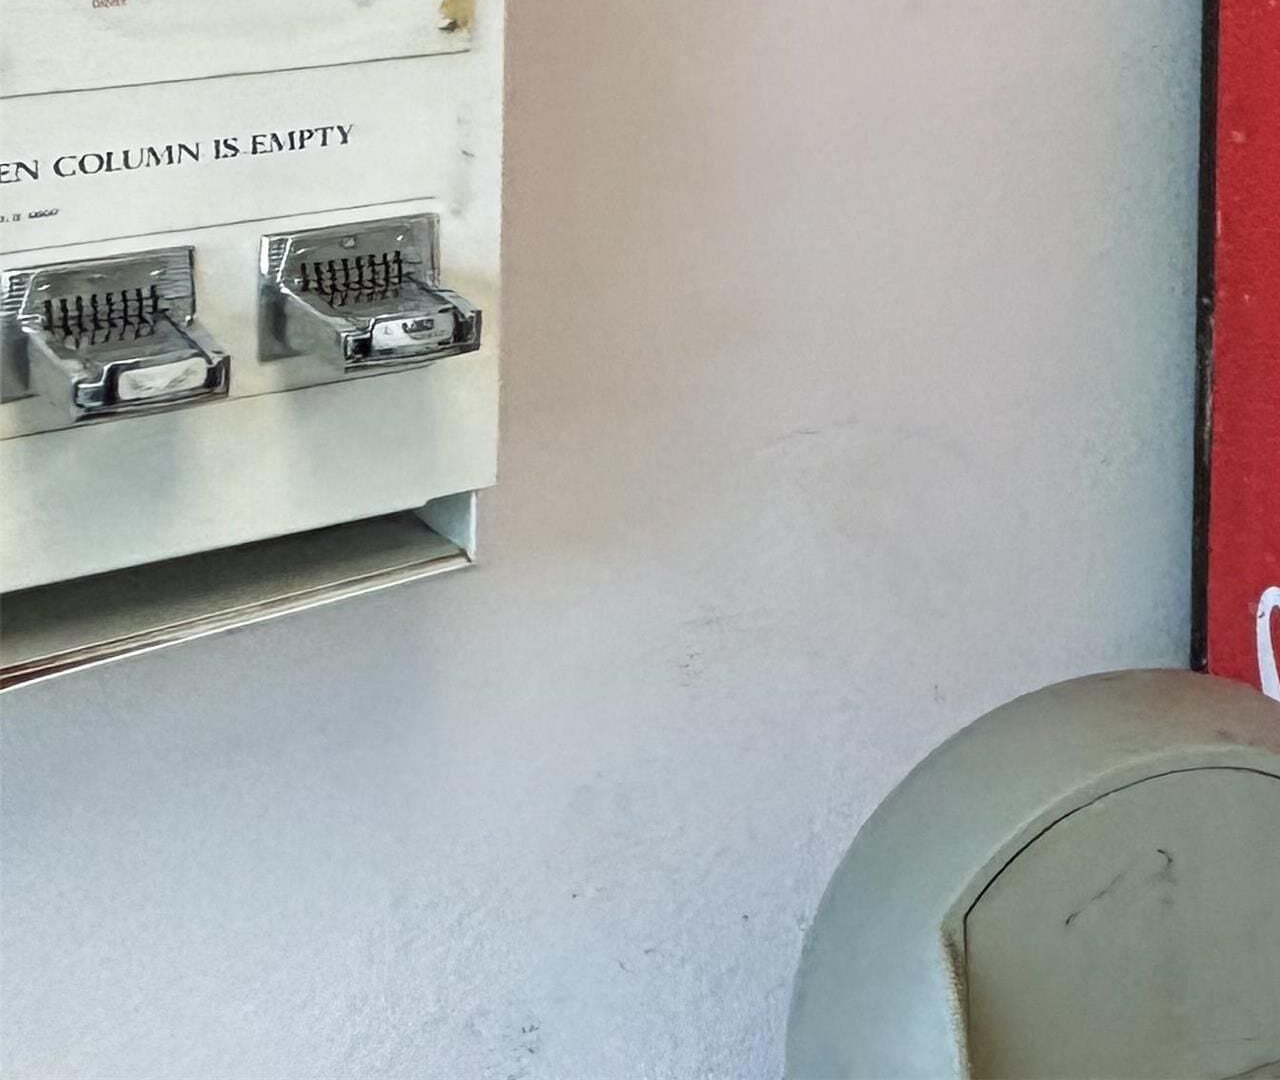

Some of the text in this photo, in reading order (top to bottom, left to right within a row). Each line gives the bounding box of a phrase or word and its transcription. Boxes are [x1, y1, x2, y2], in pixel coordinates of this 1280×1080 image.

[53, 142, 201, 178] COLUMN
[213, 136, 239, 160] IS
[250, 123, 355, 156] EMPTY
